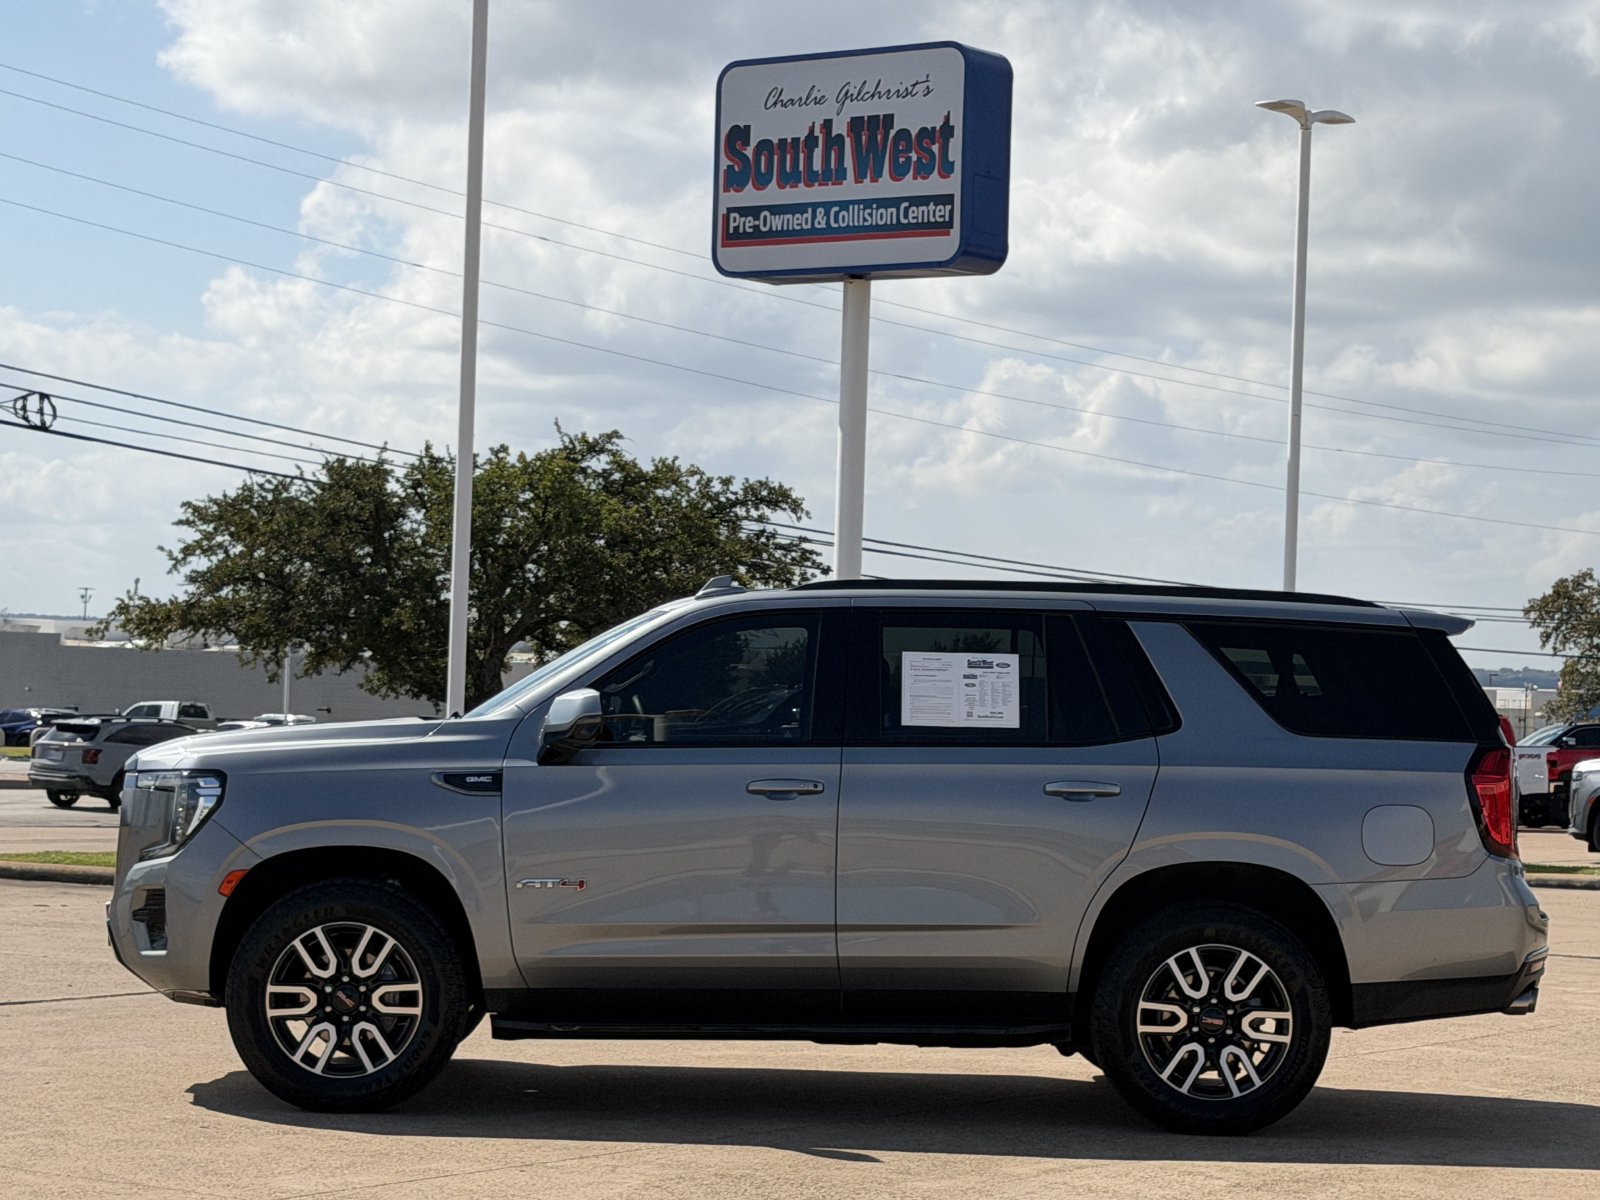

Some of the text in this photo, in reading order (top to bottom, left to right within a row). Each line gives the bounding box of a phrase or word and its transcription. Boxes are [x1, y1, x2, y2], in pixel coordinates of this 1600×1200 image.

[764, 74, 935, 116] Charlie Gilchrist's
[723, 110, 955, 193] SouthWest
[728, 201, 952, 234] Pre-Owned & Collision Center
[516, 878, 587, 892] AT4
